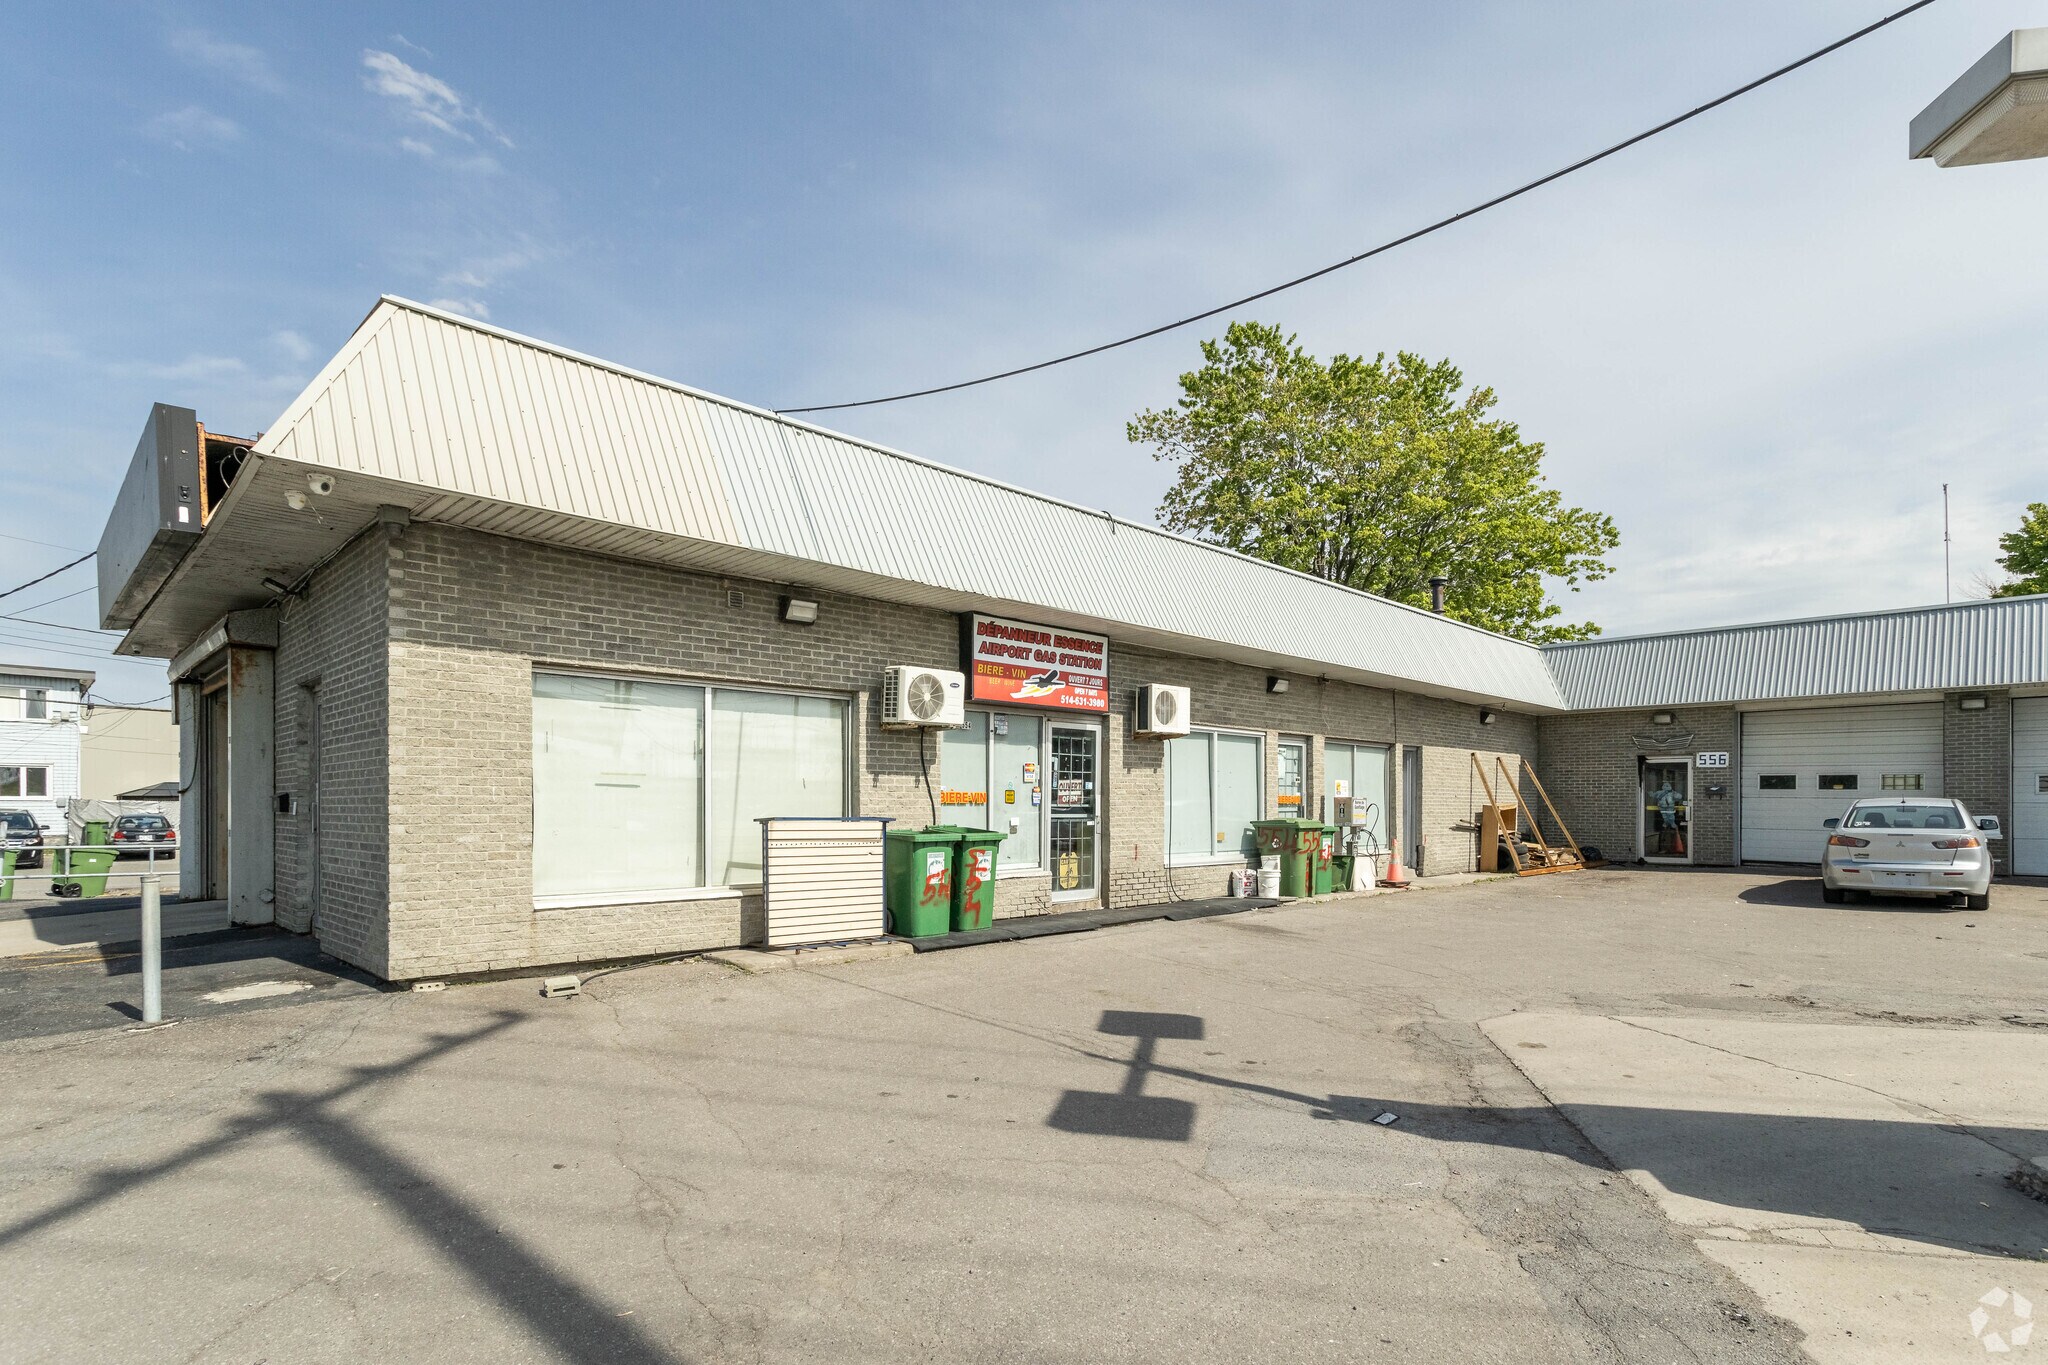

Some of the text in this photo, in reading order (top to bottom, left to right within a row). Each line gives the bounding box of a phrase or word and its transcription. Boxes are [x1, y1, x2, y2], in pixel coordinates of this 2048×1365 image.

[977, 621, 1104, 655] DÉPANNEUR ESSENCE
[978, 641, 1102, 670] AIRPORT GAS STATION
[977, 663, 1004, 676] BIÈRE
[1011, 668, 1027, 679] VIN
[1068, 675, 1085, 685] OUVERT
[1089, 678, 1103, 687] JOURS
[1699, 754, 1727, 765] 556
[1062, 795, 1078, 803] OPEN
